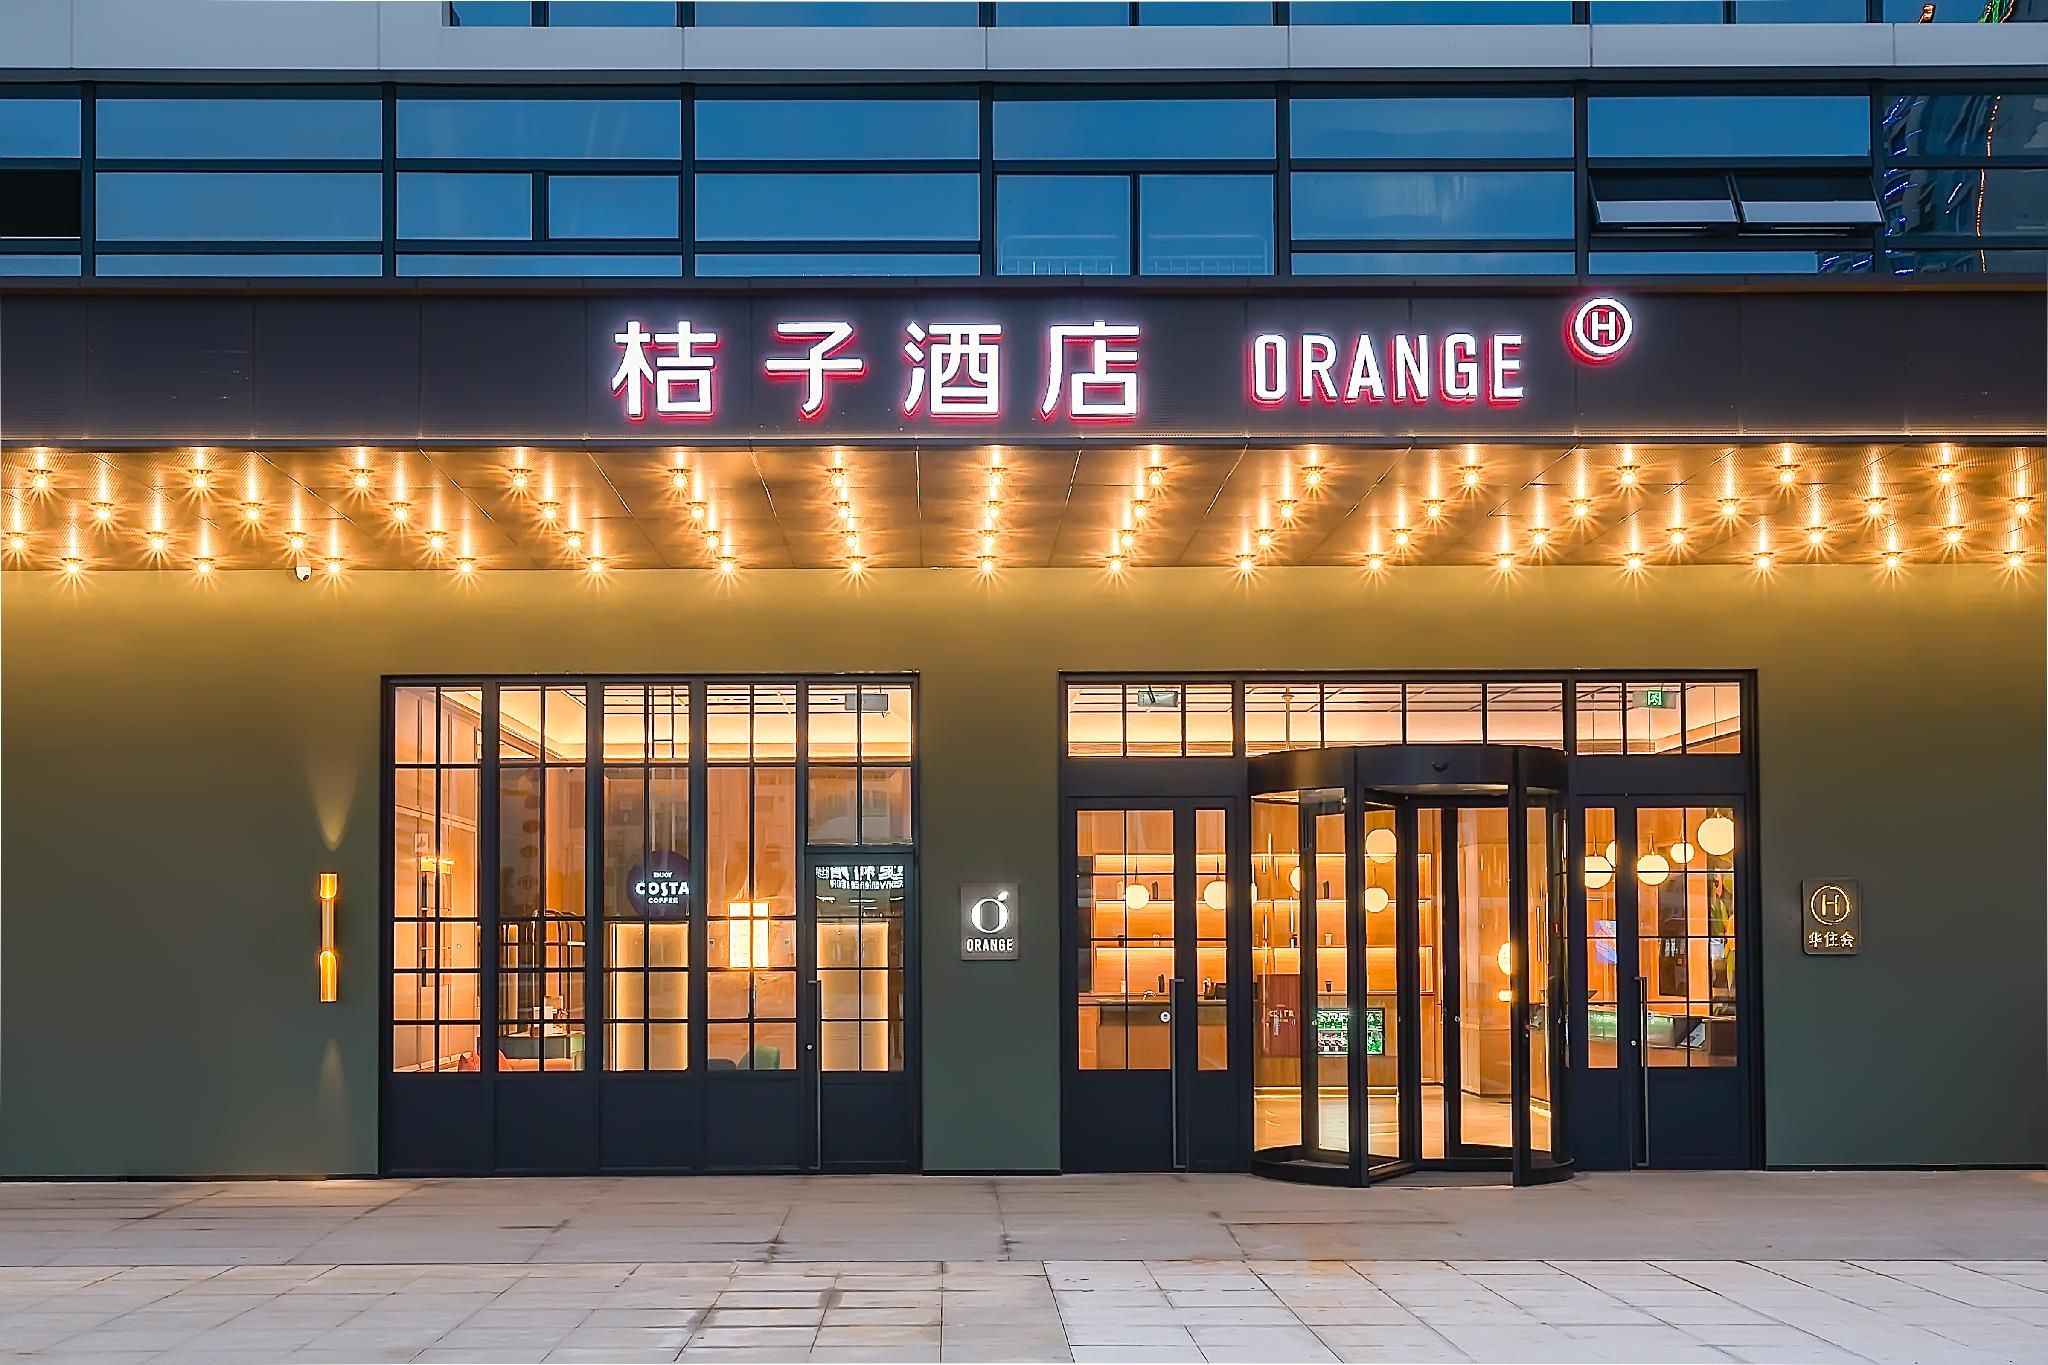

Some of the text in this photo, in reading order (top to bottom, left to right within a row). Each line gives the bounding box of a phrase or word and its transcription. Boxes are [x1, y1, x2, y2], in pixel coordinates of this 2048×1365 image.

[611, 319, 1141, 418] 桔子酒店
[1254, 333, 1524, 402] ORANGE
[635, 881, 690, 897] COSTA
[966, 938, 1014, 952] ORANGE
[1808, 931, 1855, 948] 华住会
